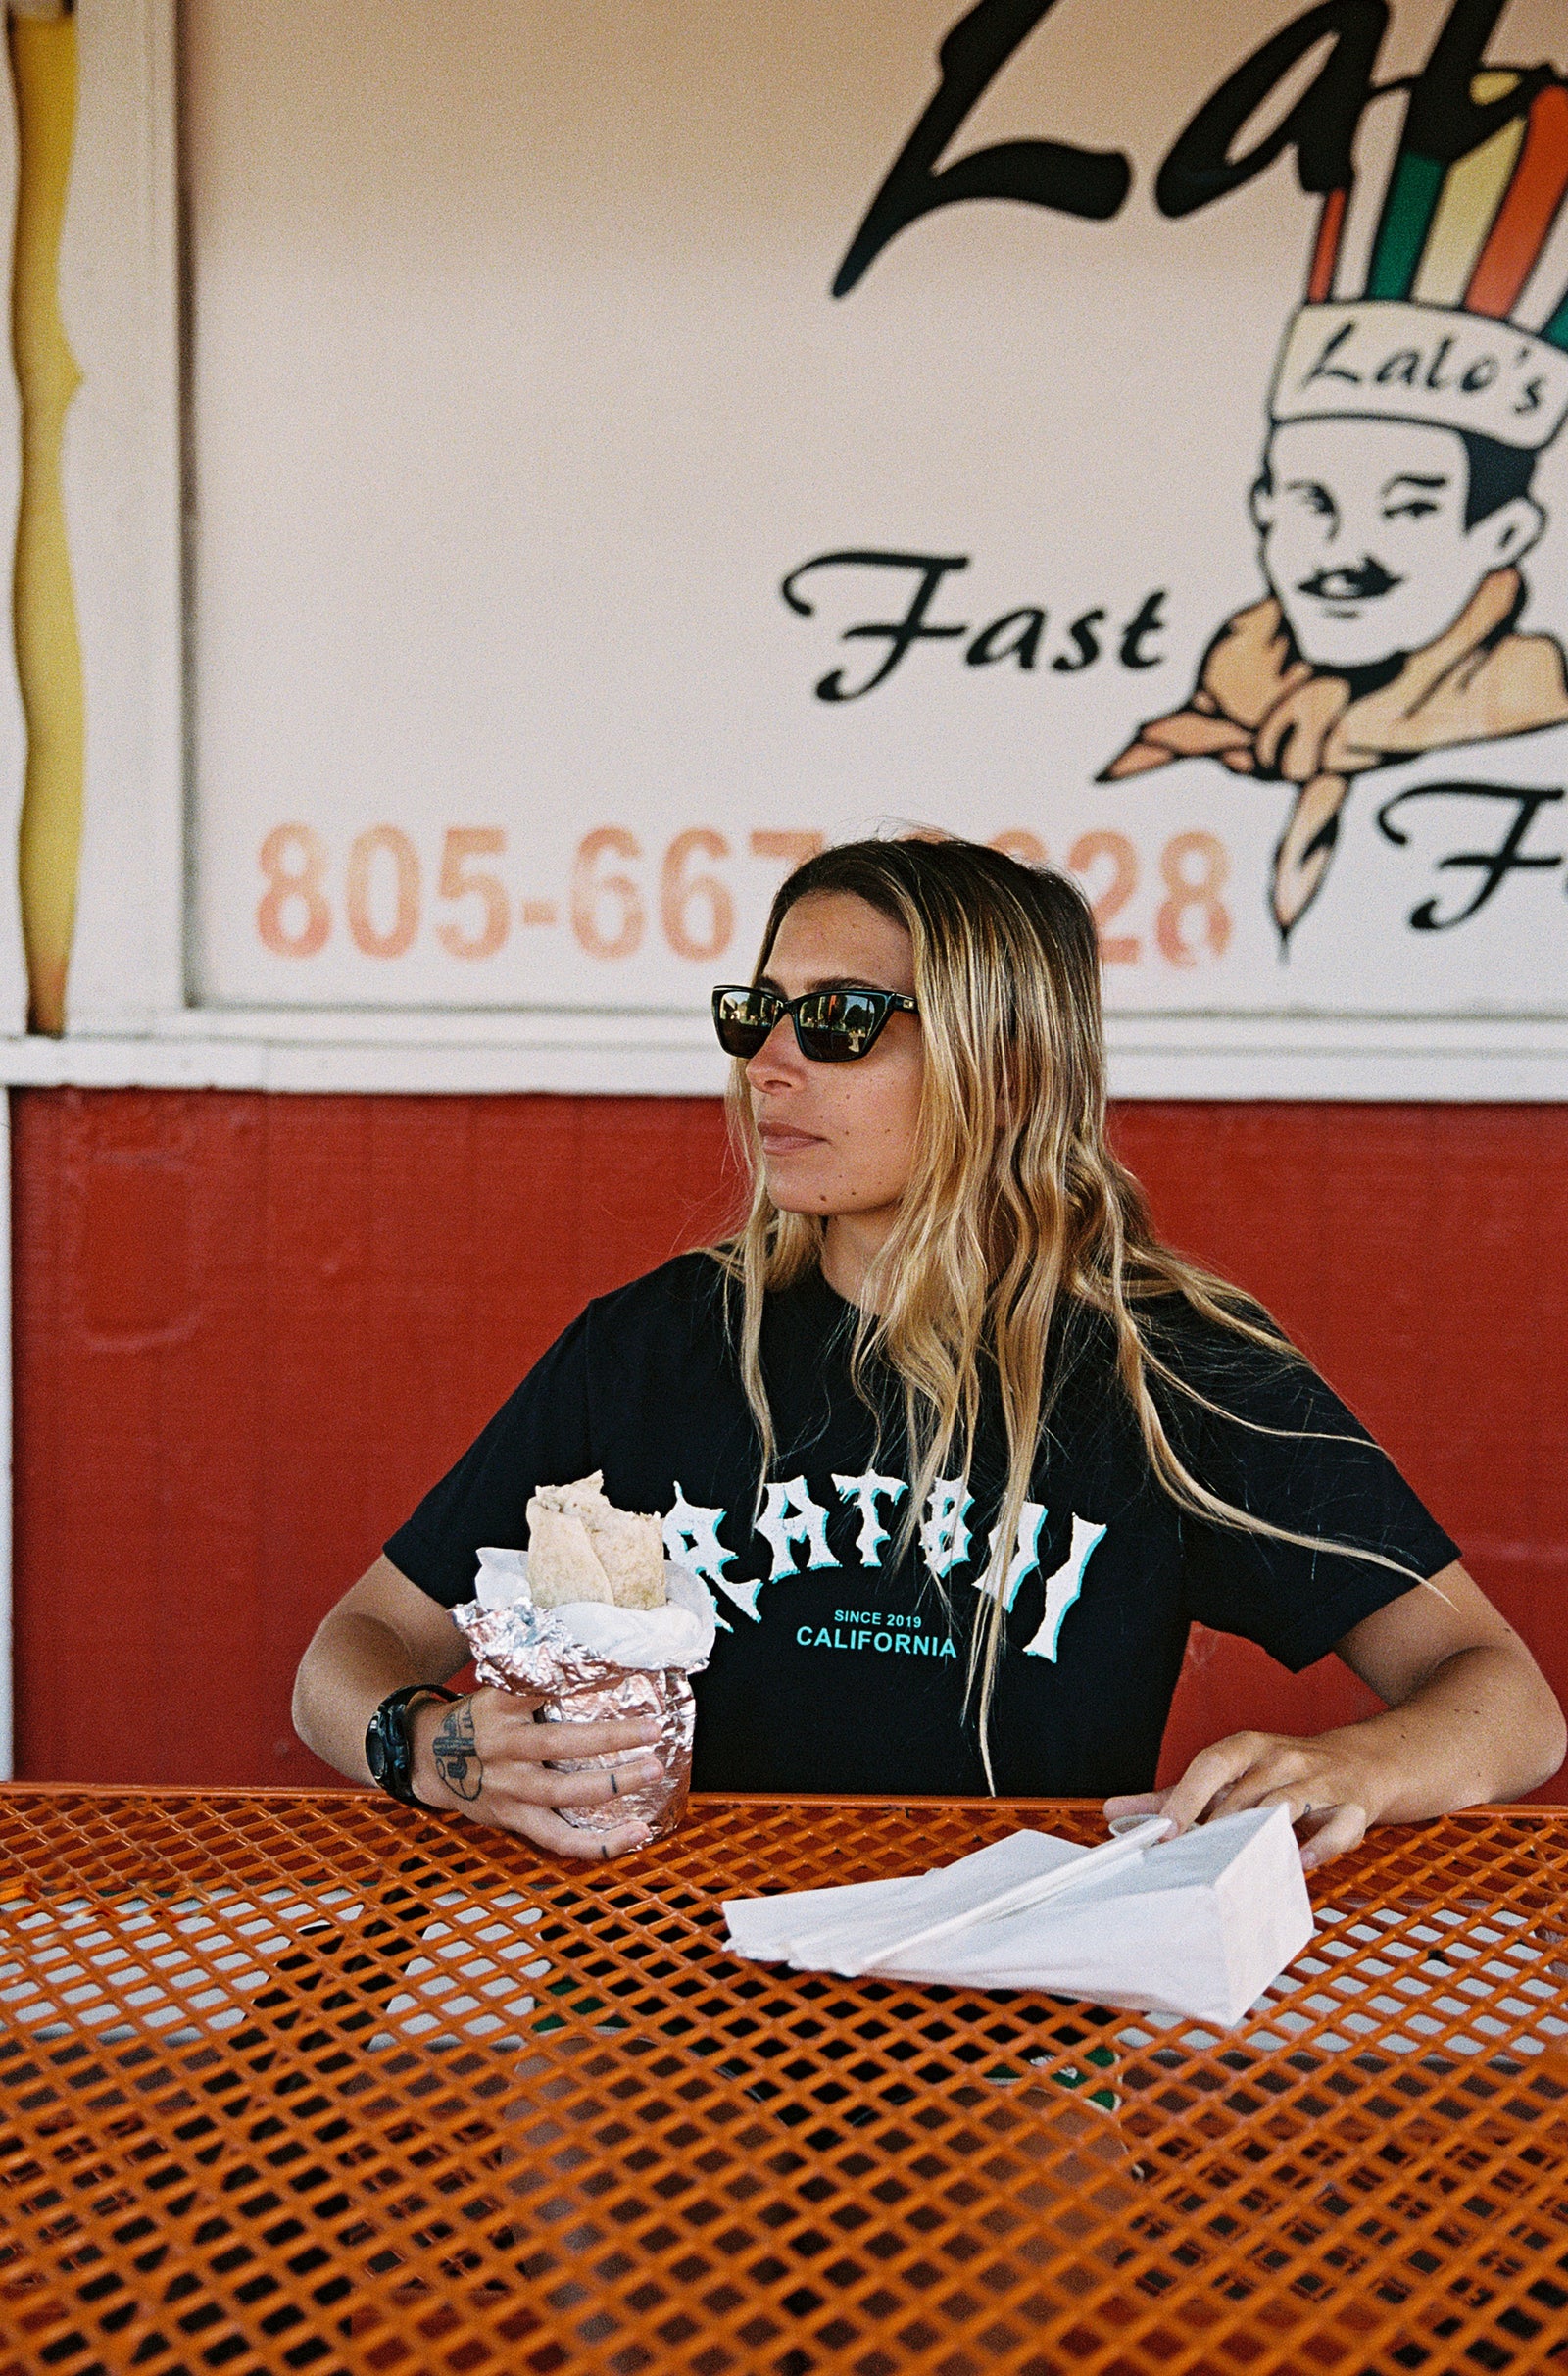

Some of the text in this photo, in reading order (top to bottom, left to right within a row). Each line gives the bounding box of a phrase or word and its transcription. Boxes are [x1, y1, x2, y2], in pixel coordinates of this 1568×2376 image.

[1300, 319, 1546, 416] Lalo's
[780, 549, 1169, 703] Fast
[1376, 780, 1568, 931] F
[795, 1625, 958, 1658] CALIFORNIA
[833, 1609, 923, 1629] SINCE 2019
